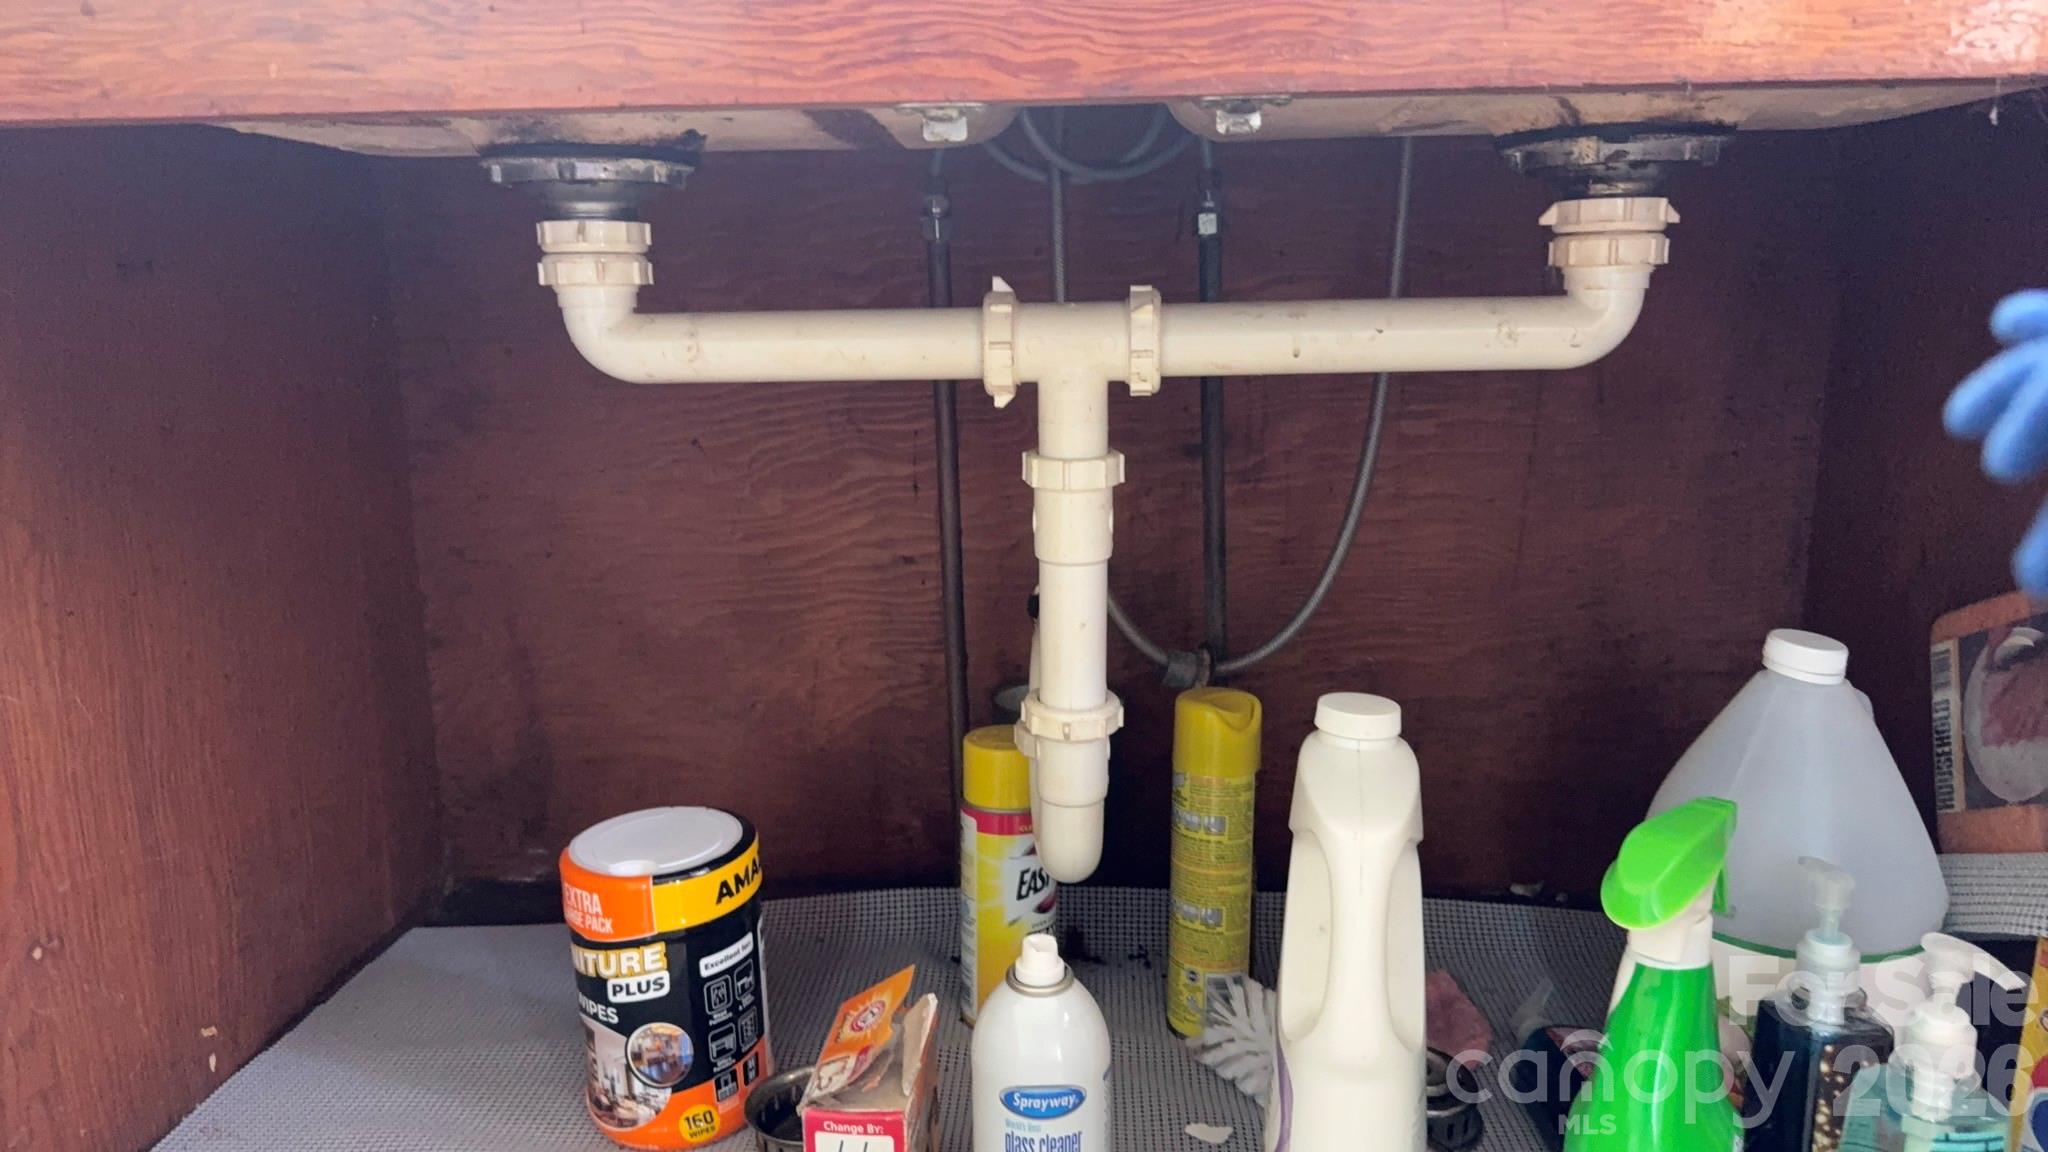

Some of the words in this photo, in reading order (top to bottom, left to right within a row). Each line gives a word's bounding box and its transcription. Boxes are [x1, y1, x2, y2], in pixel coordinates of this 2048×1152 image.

[585, 914, 614, 933] PACK
[612, 977, 665, 996] PLUS
[1013, 1092, 1077, 1113] Sprayway
[684, 1110, 714, 1130] 160
[823, 1121, 865, 1136] Change
[689, 1126, 716, 1139] WIPES
